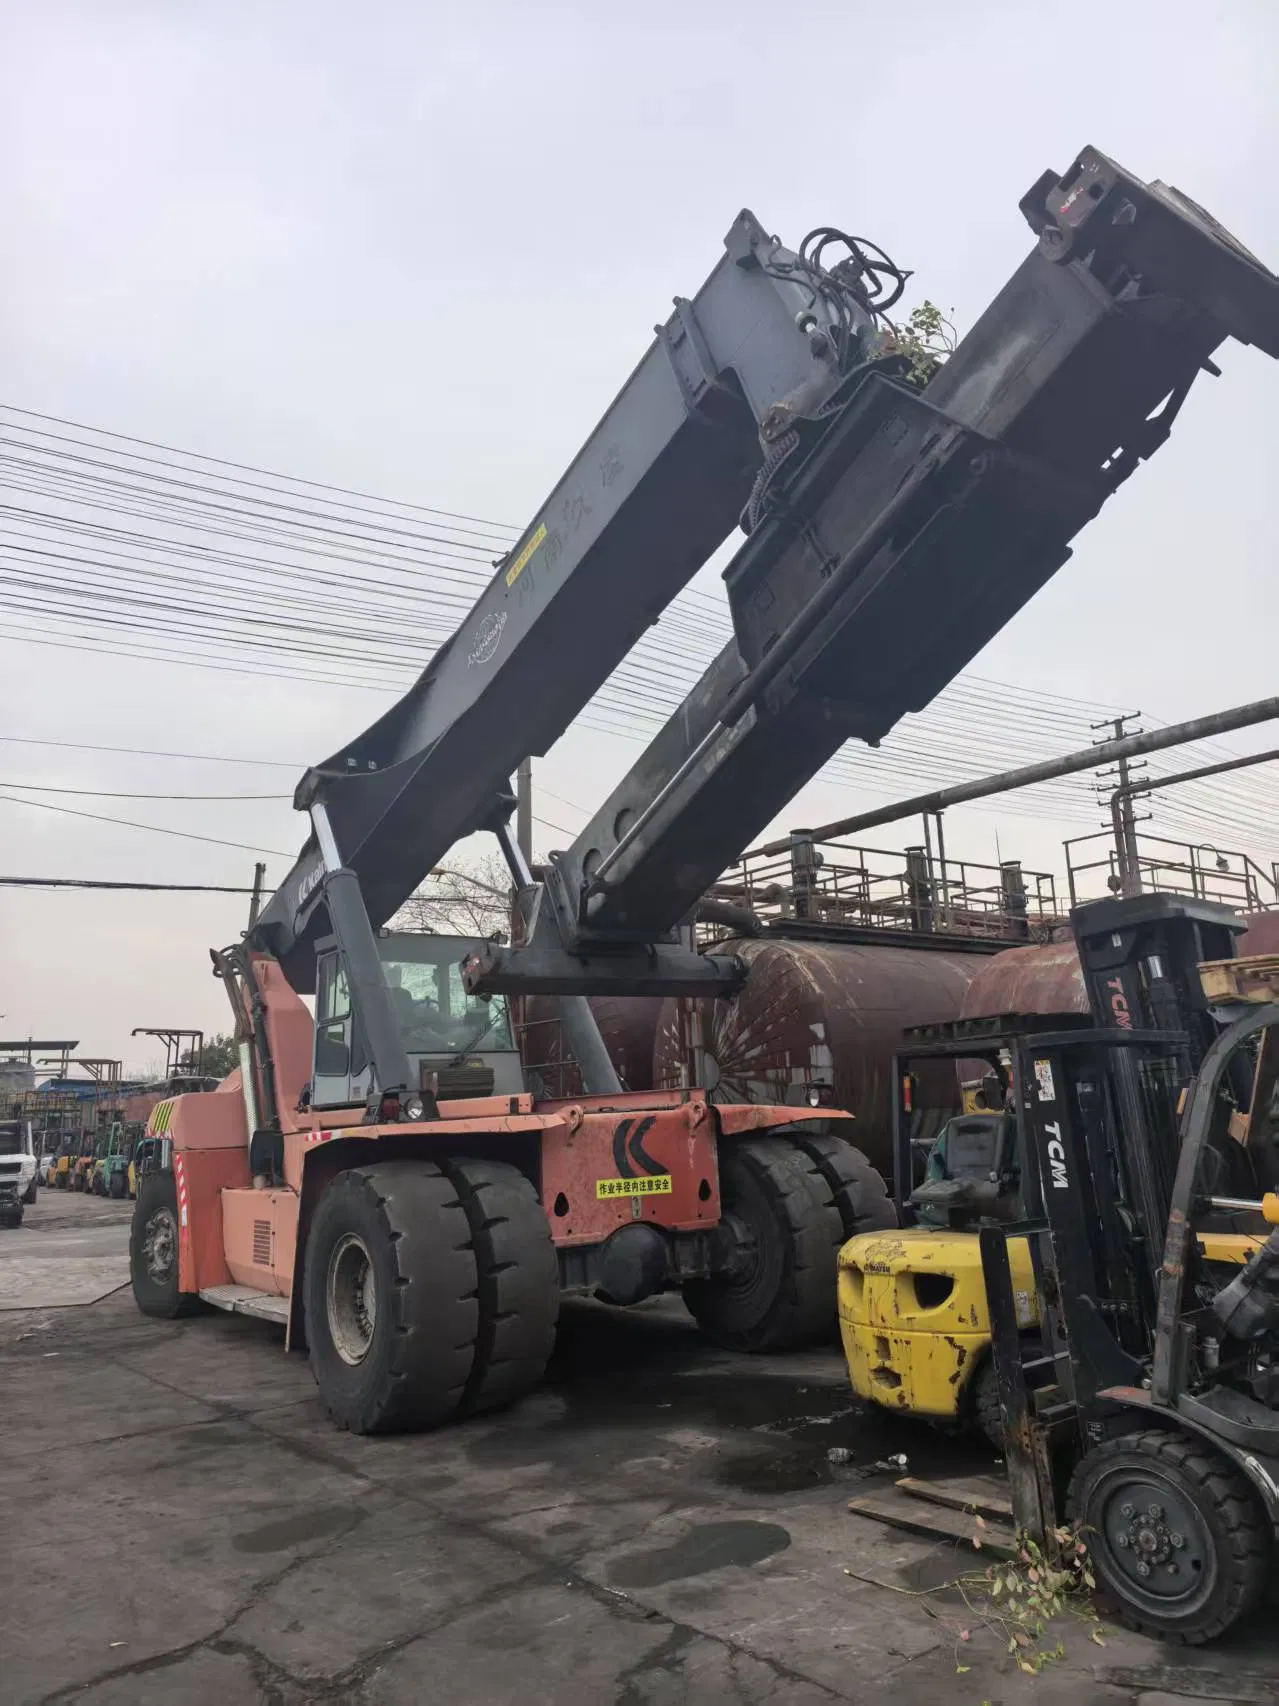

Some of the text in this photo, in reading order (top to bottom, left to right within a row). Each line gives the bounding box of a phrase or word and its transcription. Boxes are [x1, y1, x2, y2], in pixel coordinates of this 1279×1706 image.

[1107, 976, 1133, 1031] TCM
[1044, 1120, 1069, 1189] TCM
[599, 1178, 670, 1195] 作业半径内注意安全
